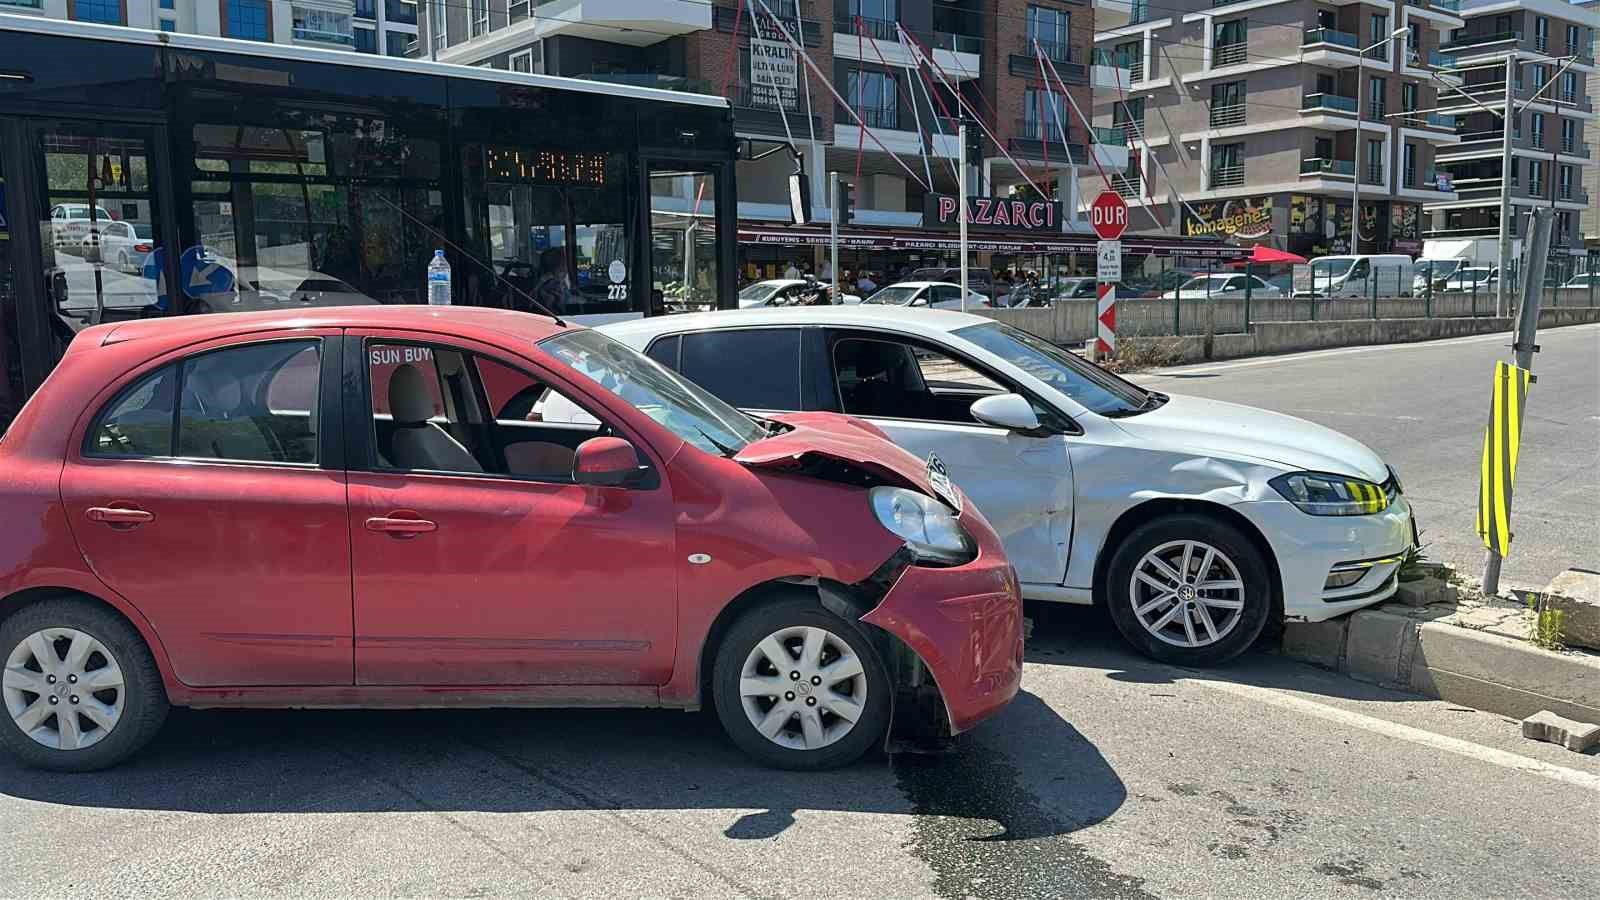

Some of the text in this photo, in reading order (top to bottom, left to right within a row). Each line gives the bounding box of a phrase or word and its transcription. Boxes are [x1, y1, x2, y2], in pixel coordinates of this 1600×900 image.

[1094, 206, 1125, 225] DUR
[1186, 210, 1263, 237] komagene
[607, 284, 627, 300] 273
